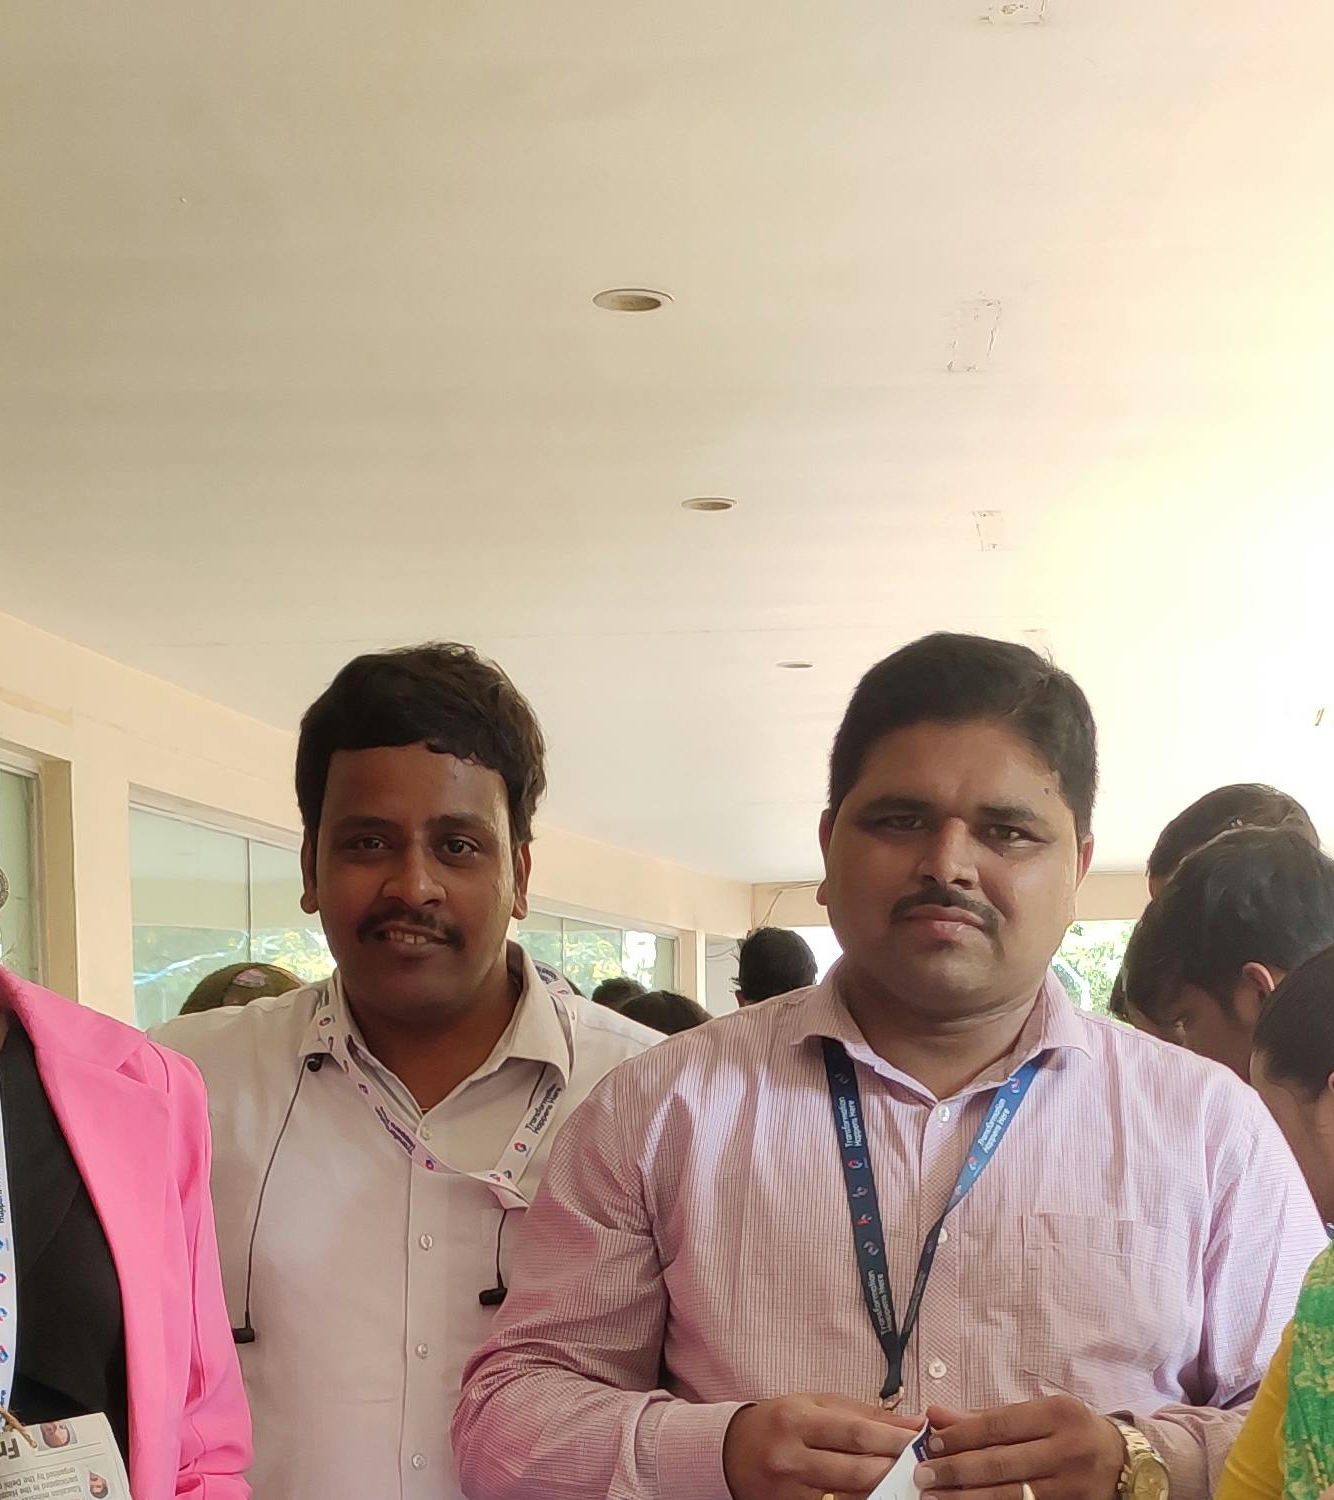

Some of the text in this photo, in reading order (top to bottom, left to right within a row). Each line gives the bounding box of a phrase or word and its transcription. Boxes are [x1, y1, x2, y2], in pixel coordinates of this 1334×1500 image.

[838, 1096, 853, 1148] Transformation
[847, 1099, 862, 1148] Happens Here
